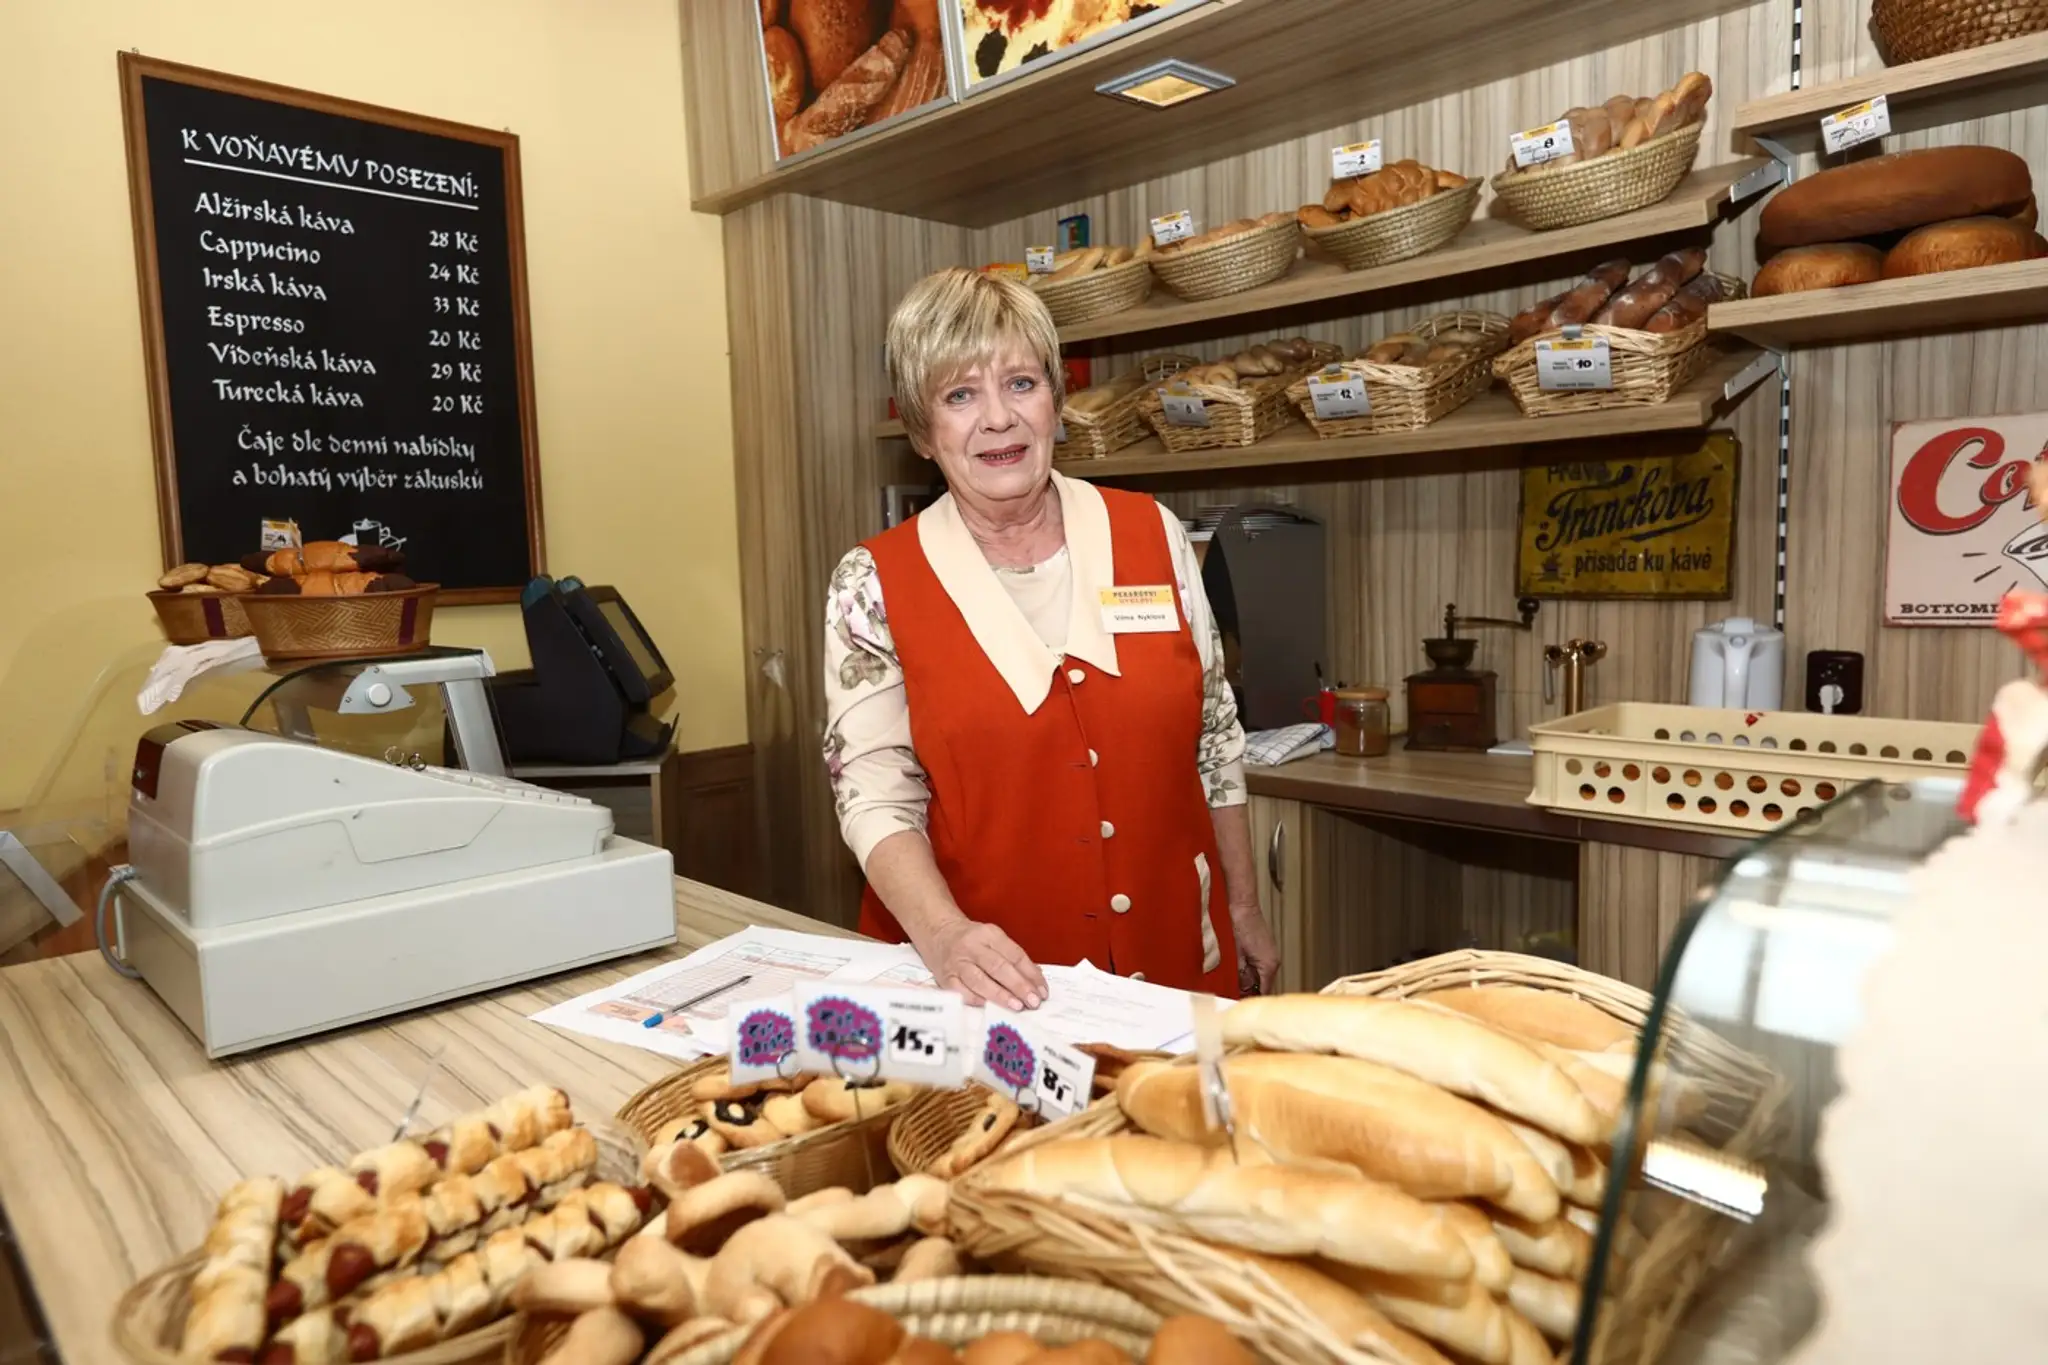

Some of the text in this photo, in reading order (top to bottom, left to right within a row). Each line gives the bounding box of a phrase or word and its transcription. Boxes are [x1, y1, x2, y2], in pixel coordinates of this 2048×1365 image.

[180, 128, 201, 151] K
[194, 191, 355, 234] Alžírská káva
[199, 229, 321, 265] Cappucino
[428, 230, 478, 254] 28 Kč
[202, 267, 327, 301] Irská káva
[428, 262, 480, 285] 24 Kč
[433, 296, 480, 317] 33 Kč
[207, 305, 305, 336] Espresso
[428, 329, 481, 351] 20 Kč
[207, 341, 377, 375] Vídeňská káva
[1576, 358, 1593, 370] 10
[430, 361, 482, 383] 29 Kč
[211, 378, 364, 408] Turecká káva
[431, 394, 483, 414] 20 Kč
[237, 424, 285, 457] Čaje
[291, 429, 322, 453] dle
[232, 469, 248, 486] a
[252, 462, 332, 493] bohatý
[1643, 547, 1665, 572] ku
